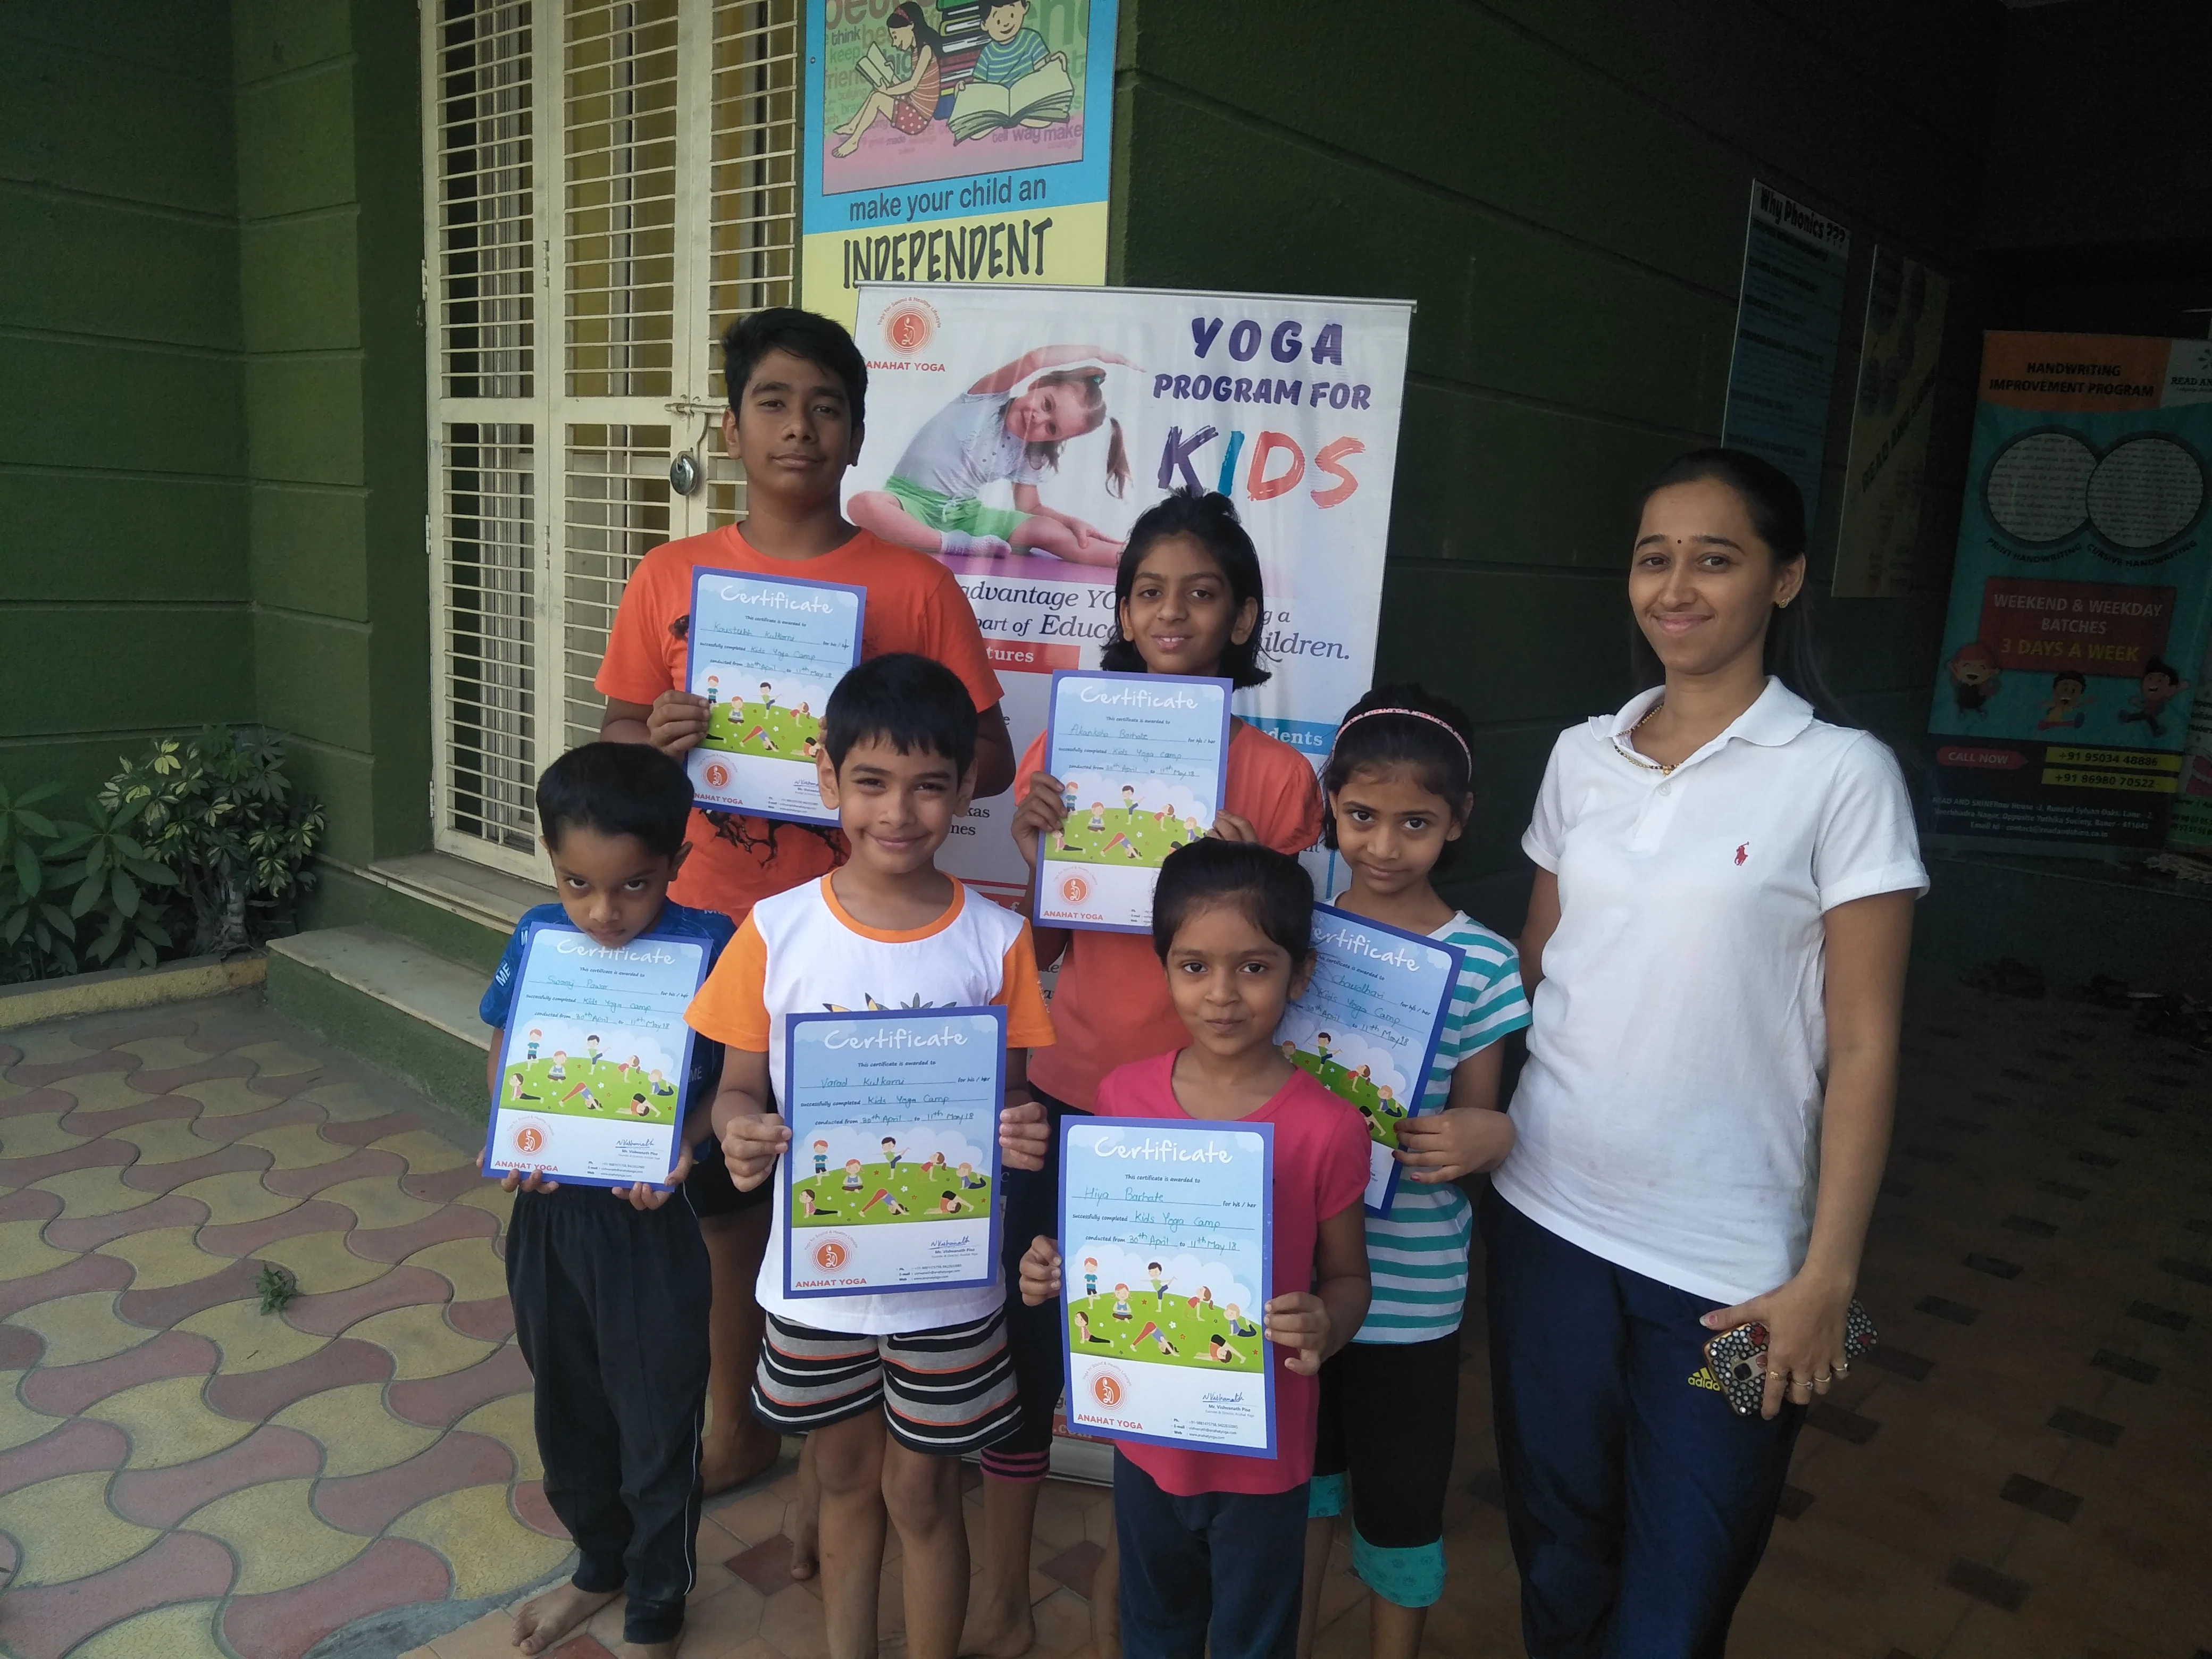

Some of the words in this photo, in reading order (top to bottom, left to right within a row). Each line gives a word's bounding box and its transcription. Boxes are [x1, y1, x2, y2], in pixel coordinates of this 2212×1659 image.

[832, 27, 860, 45] think
[830, 46, 860, 64] keep
[1012, 127, 1041, 145] way
[1043, 123, 1083, 143] make
[850, 192, 901, 222] make
[908, 190, 954, 221] your
[960, 175, 1011, 209] child
[1019, 178, 1046, 200] an
[1761, 187, 1783, 225] Why
[1784, 200, 1824, 240] Phonics
[843, 217, 1053, 289] INDEPENDENT
[891, 297, 907, 307] Sound
[914, 297, 931, 308] Healthy
[1192, 317, 1343, 366] YOGA
[866, 361, 911, 370] ANAHAT
[914, 363, 945, 372] YOGA
[2027, 362, 2121, 376] HANDWRITING
[1153, 373, 1303, 406] PROGRAM
[1309, 381, 1372, 410] FOR
[1989, 379, 2084, 393] IMPROVEMENT
[2088, 384, 2155, 397] PROGRAM
[1157, 425, 1365, 509] KIDS
[1986, 537, 2012, 557] PRINT
[2013, 542, 2083, 563] HANDWRITING
[2087, 543, 2123, 567] CURSIVE
[2125, 540, 2198, 567] HANDWRITING
[720, 585, 833, 614] Certificate
[1087, 589, 1117, 610] YO
[1994, 594, 2067, 611] WEEKEND
[2072, 599, 2084, 611] &
[2090, 600, 2163, 617] WEEKDAY
[1278, 611, 1291, 623] a
[2041, 617, 2107, 634] BATCHES
[1012, 618, 1033, 636] of
[1039, 614, 1117, 639] Educ
[1260, 631, 1350, 660] ildren.
[986, 646, 1034, 663] tures
[2001, 638, 2012, 653] 3
[2018, 639, 2064, 657] DAYS
[2068, 641, 2083, 658] A
[2089, 644, 2140, 661] WEEK
[1080, 686, 1199, 709] Certificate
[1263, 727, 1323, 747] dents
[1948, 751, 1976, 763] CALL
[1979, 753, 2009, 765] NOW
[2059, 751, 2081, 761] +91
[2085, 752, 2119, 763] 95034
[2123, 756, 2158, 766] 48886
[2055, 773, 2077, 783] +91
[2081, 774, 2116, 785] 86980
[2120, 776, 2155, 788] 70522
[694, 793, 720, 802] NAHAT
[722, 795, 743, 805] YOGA
[966, 807, 990, 818] kas
[557, 939, 676, 965] Certificate
[1312, 927, 1420, 971] ertificate
[1375, 1008, 1400, 1027] Camp
[824, 1026, 968, 1050] Certificate
[822, 1077, 848, 1088] Varad
[868, 1096, 886, 1104] Kids
[896, 1095, 916, 1109] Yoga
[924, 1094, 950, 1105] Camp
[883, 1115, 901, 1126] April
[1094, 1136, 1233, 1163] Certificate
[495, 1160, 532, 1170] ANAHAT
[534, 1163, 559, 1172] YOGA
[1085, 1186, 1109, 1206] Hiya
[1135, 1210, 1154, 1222] Kids
[1162, 1212, 1184, 1233] Yoga
[1194, 1217, 1220, 1231] Camp
[1150, 1235, 1169, 1250] April
[1208, 1241, 1225, 1255] May
[1229, 1242, 1236, 1250] 18
[795, 1279, 836, 1288] ANAHAT
[839, 1278, 867, 1286] YOGA
[1077, 1413, 1115, 1427] ANAHAT
[1117, 1418, 1143, 1430] YOGA
